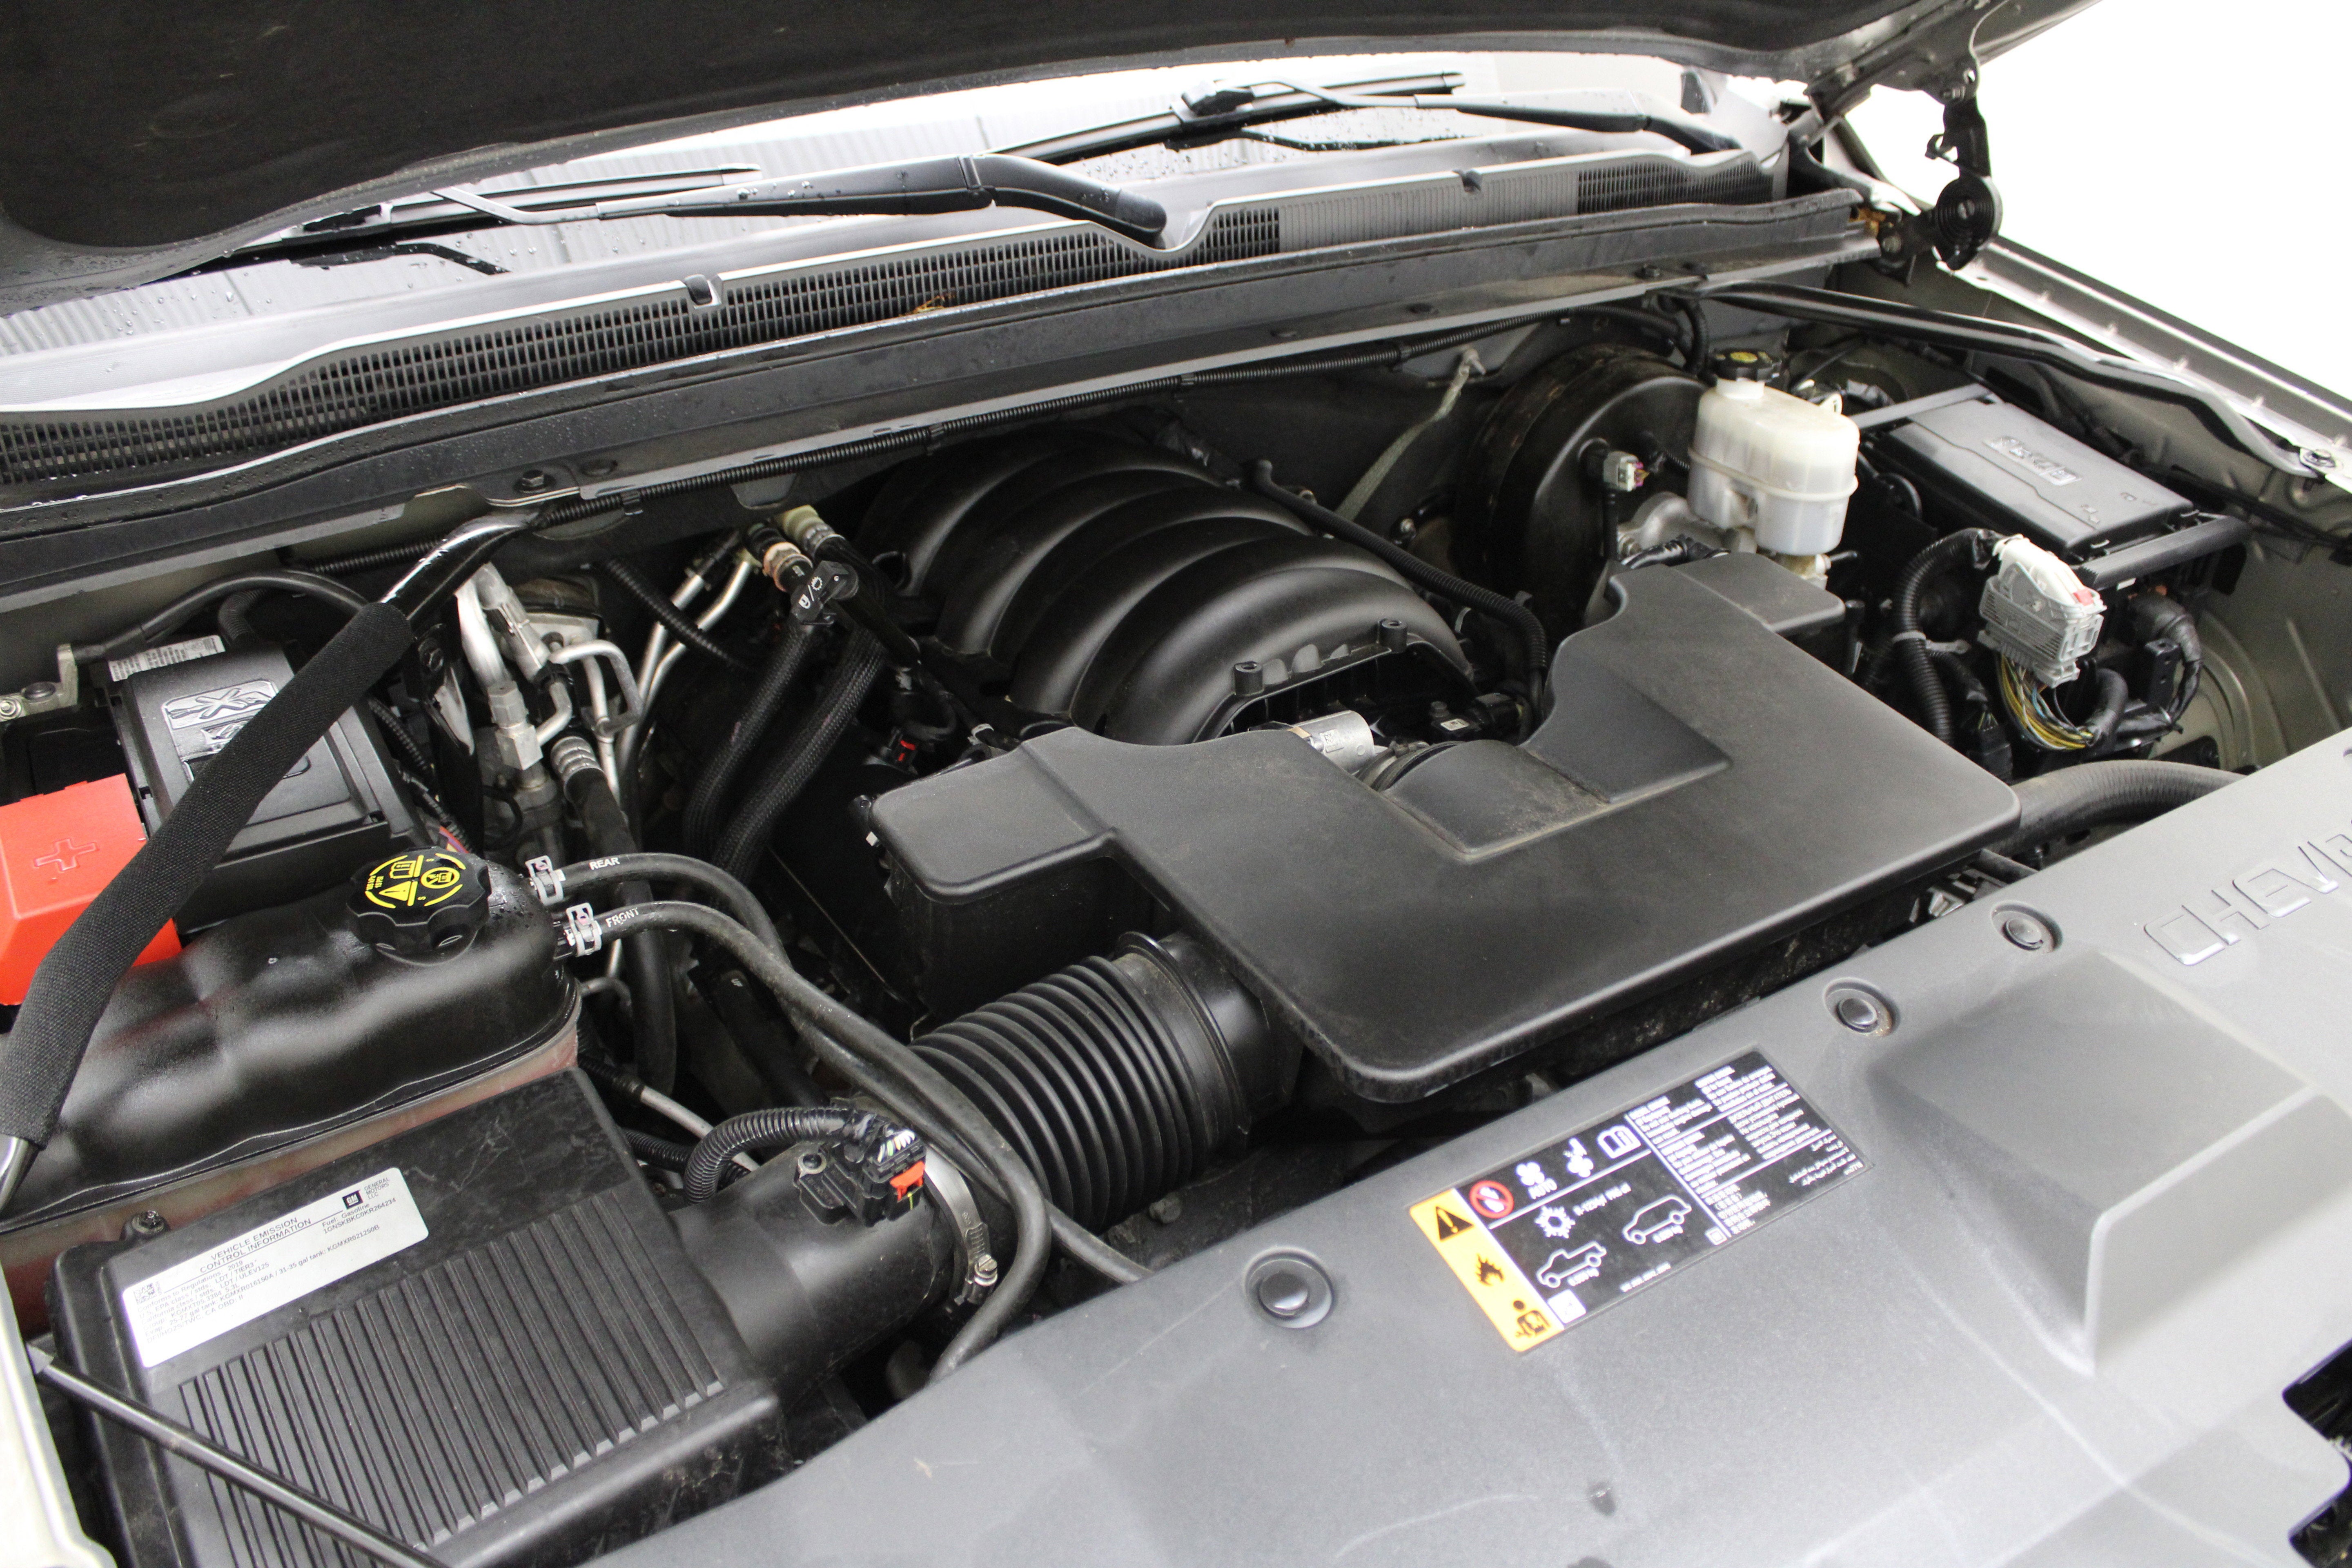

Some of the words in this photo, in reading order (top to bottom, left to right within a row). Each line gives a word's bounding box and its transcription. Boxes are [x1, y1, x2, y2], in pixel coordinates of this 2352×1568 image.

[589, 857, 621, 870] REAR
[605, 907, 640, 928] FRONT
[1737, 1079, 1763, 1095] producir
[1646, 1118, 1662, 1129] not
[1655, 1114, 1671, 1125] use
[1664, 1105, 1691, 1120] starting
[1671, 1112, 1693, 1126] engine
[1688, 1102, 1713, 1117] damage
[1727, 1101, 1765, 1124] ДИЗЕЛЬНЫЙ
[1758, 1088, 1792, 1108] ДВИГАТЕЛЬ
[1732, 1117, 1752, 1130] (если
[1766, 1120, 1780, 1131] для
[1651, 1134, 1665, 1145] can
[364, 1177, 390, 1191] GENERAL
[365, 1182, 389, 1195] MOTORS
[1528, 1178, 1557, 1200] AUTO
[322, 1217, 336, 1227] Fuel:
[341, 1203, 369, 1218] Gasoline
[1572, 1194, 1607, 1216] R-1234yf
[199, 1250, 246, 1273] CONTROL
[247, 1218, 311, 1251] INFORMATION
[210, 1238, 250, 1260] VEHICLE
[253, 1217, 297, 1241] EMISSION
[137, 1294, 171, 1313] Conforms
[180, 1272, 221, 1292] Regulations:
[227, 1260, 243, 1271] 2019
[141, 1307, 174, 1325] California
[176, 1298, 194, 1308] class
[199, 1288, 214, 1297] stds:
[220, 1278, 233, 1288] LDT
[238, 1261, 270, 1279] ULEV125
[155, 1302, 169, 1312] EPA
[171, 1293, 189, 1304] class
[194, 1284, 209, 1293] stds:
[215, 1273, 228, 1283] LDT
[189, 1307, 200, 1317] gal
[278, 1262, 297, 1274] 31-35
[298, 1256, 308, 1266] gal
[309, 1250, 326, 1260] tank:
[225, 1283, 239, 1292] 5.3L
